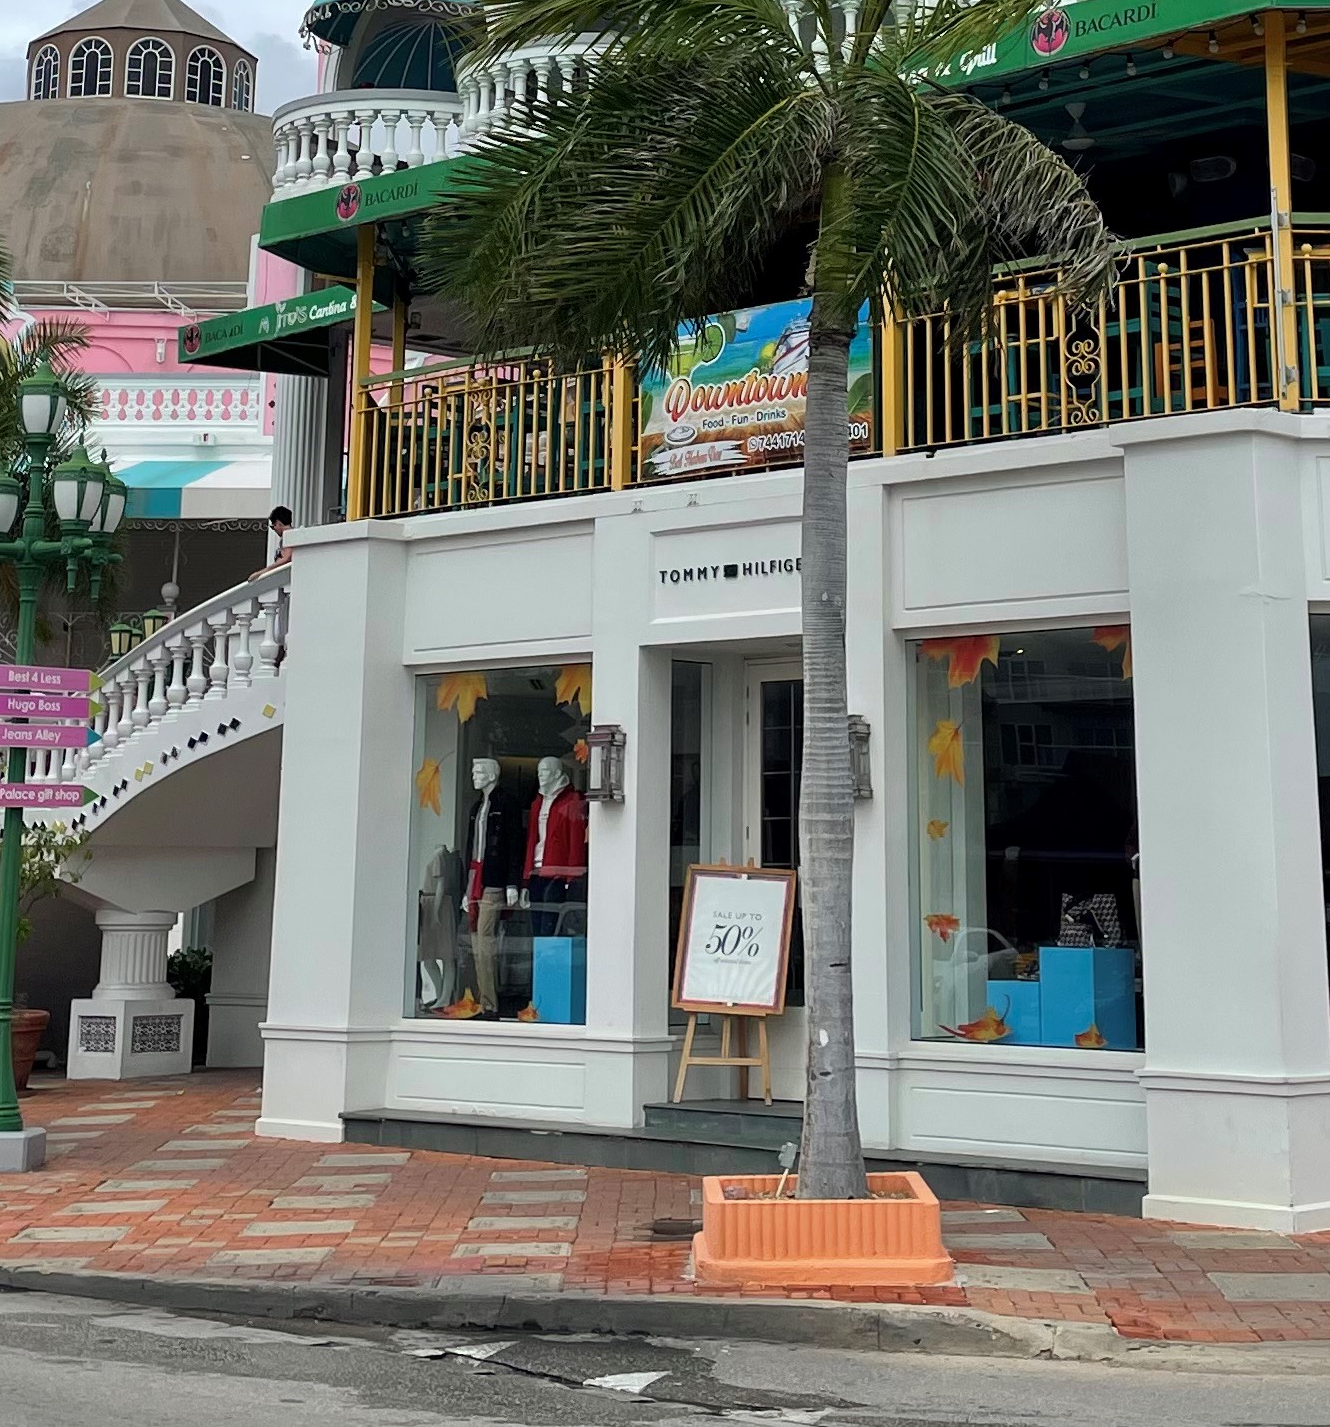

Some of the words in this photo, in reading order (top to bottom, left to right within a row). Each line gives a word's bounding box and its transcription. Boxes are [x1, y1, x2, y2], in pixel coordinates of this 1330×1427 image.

[309, 300, 347, 320] Cantina
[664, 369, 808, 422] Downtown
[702, 417, 724, 429] Food
[731, 414, 749, 425] Fun
[756, 408, 787, 422] Drinks
[758, 432, 805, 450] 7441714
[659, 565, 720, 584] TOMMY
[742, 557, 803, 577] HILFIGE
[8, 670, 30, 684] Best
[31, 672, 39, 684] 4
[41, 672, 62, 685] Less
[7, 698, 36, 713] Hugo
[38, 699, 61, 712] Boss
[2, 728, 33, 741] Jeans
[35, 729, 62, 744] Alley
[0, 789, 35, 800] Palace
[38, 788, 54, 802] gift
[54, 789, 80, 803] shop
[713, 911, 732, 920] SALE
[735, 912, 747, 920] UP
[749, 913, 763, 921] TO
[704, 924, 764, 957] 50%
